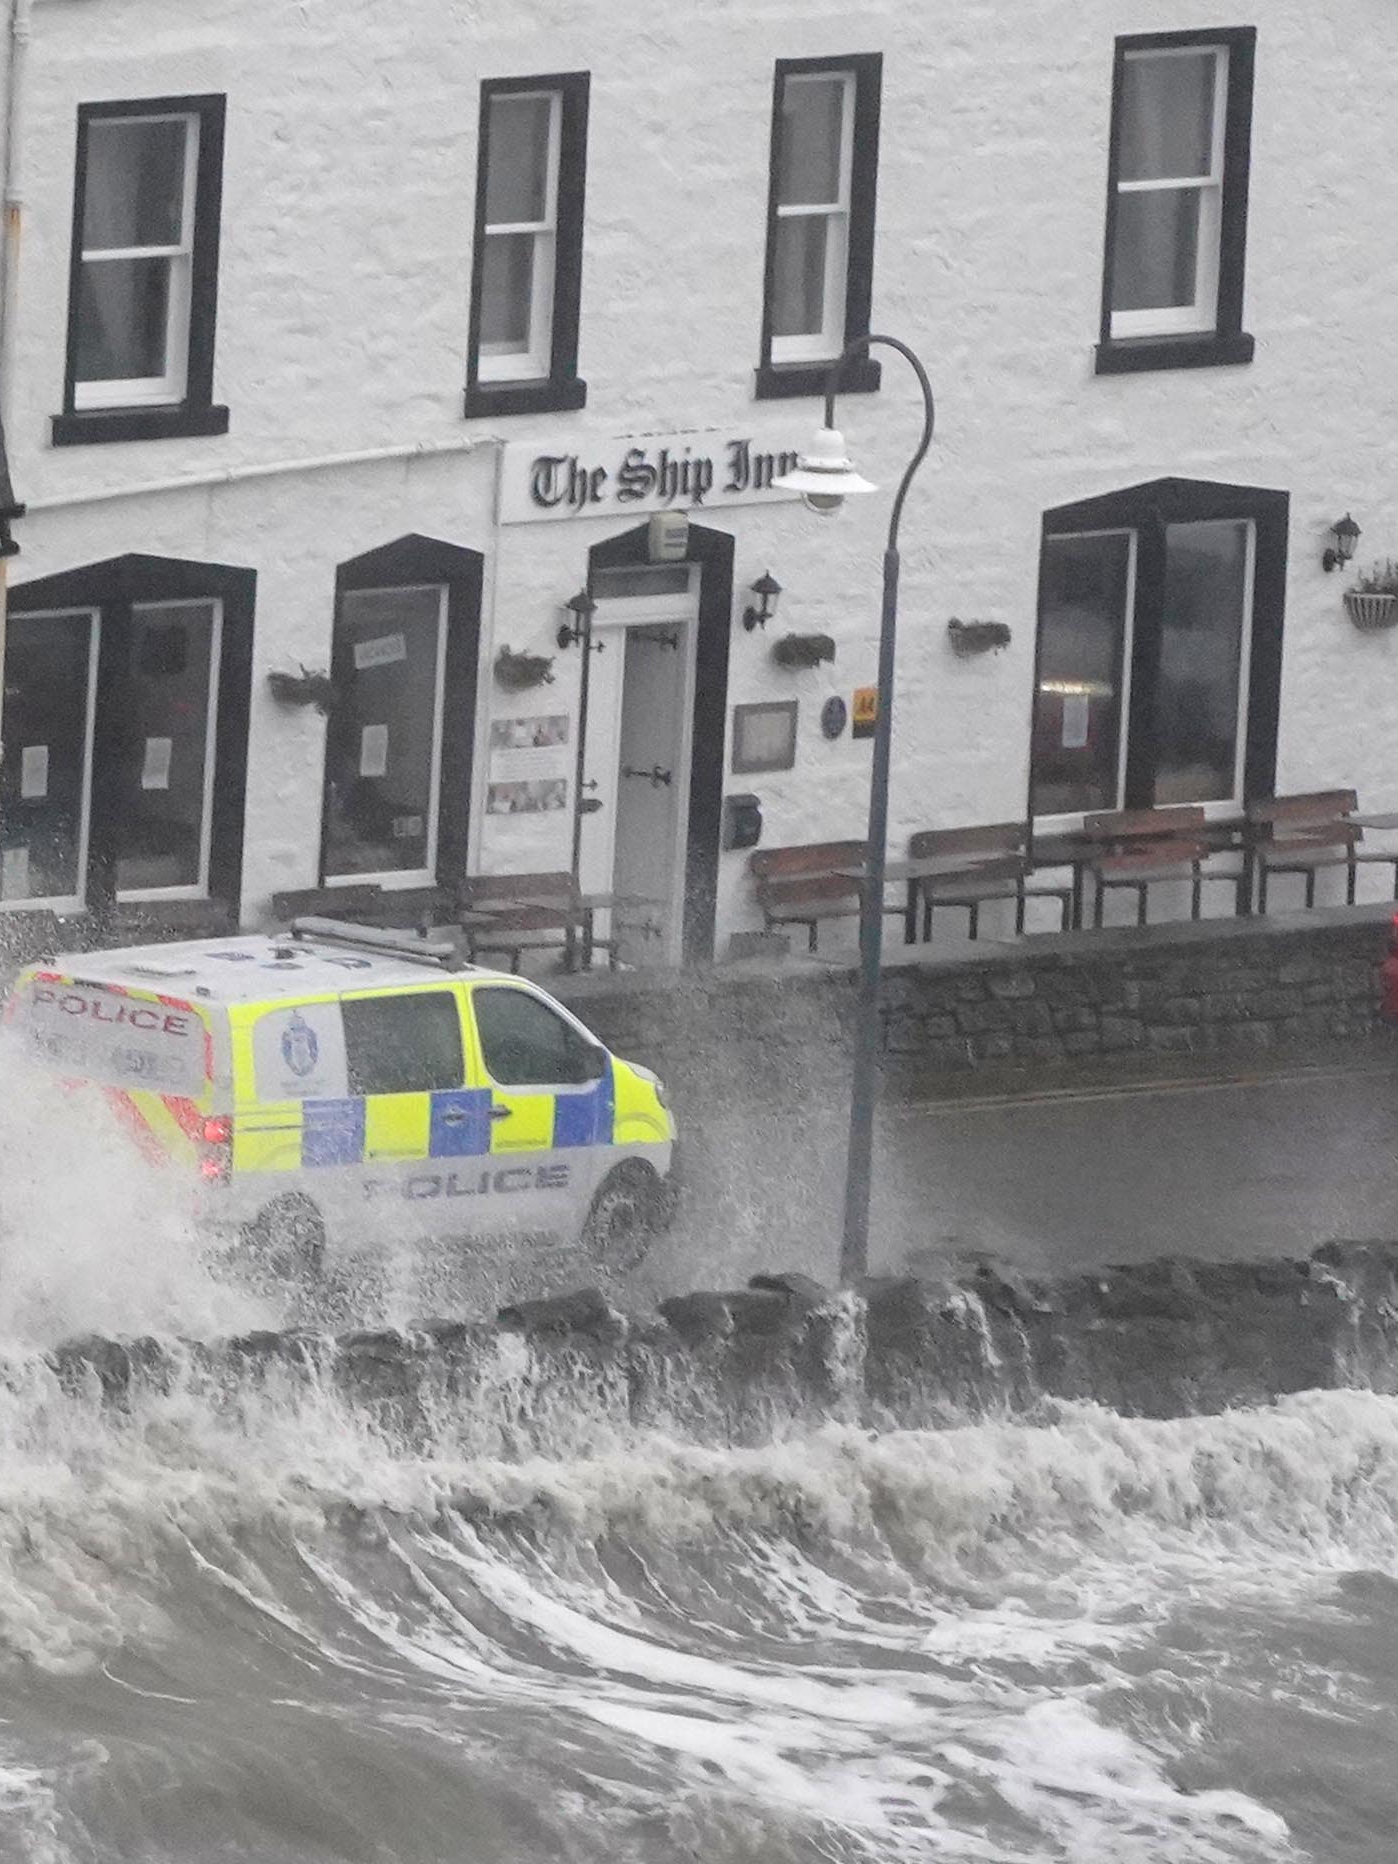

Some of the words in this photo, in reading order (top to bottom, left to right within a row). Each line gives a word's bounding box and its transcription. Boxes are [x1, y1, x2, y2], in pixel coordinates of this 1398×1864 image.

[530, 453, 609, 515] The
[616, 446, 714, 506] Ship
[723, 438, 799, 495] Inn
[31, 987, 191, 1038] POLICE
